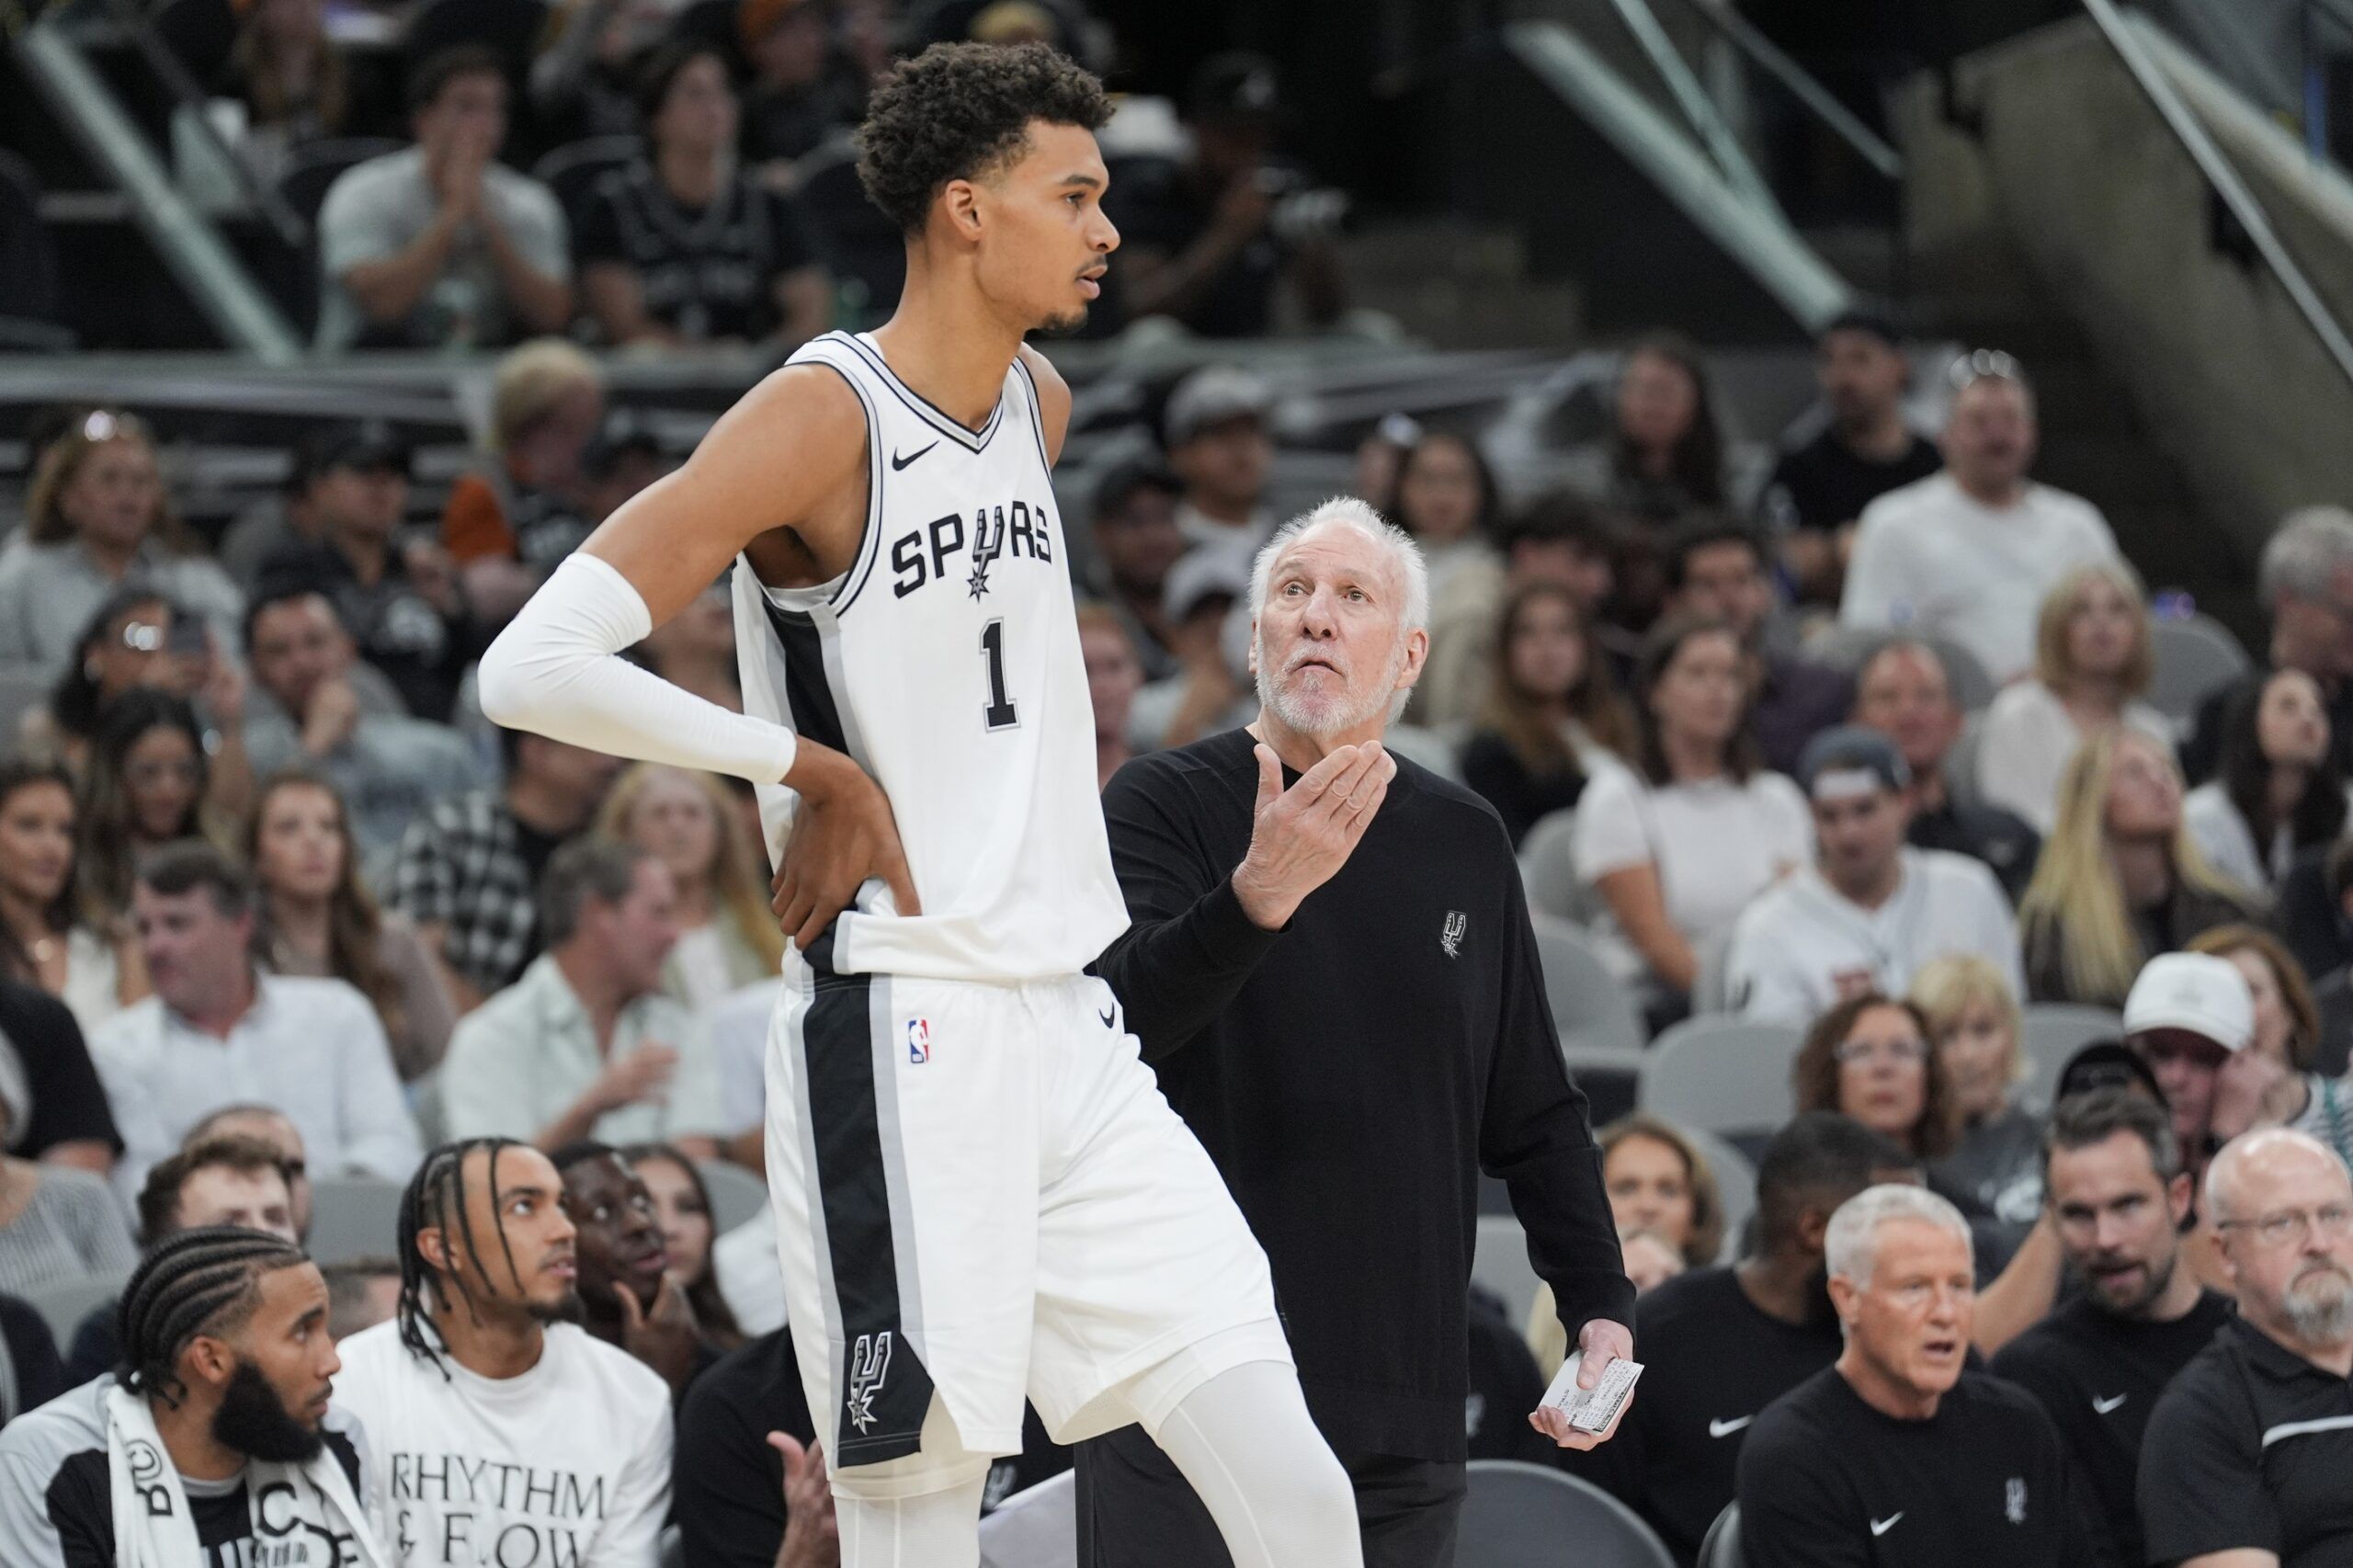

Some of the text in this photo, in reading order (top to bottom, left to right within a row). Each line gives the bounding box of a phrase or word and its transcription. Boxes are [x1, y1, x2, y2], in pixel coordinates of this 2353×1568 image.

[891, 500, 1052, 604] SPURS
[980, 617, 1021, 733] 1
[390, 1452, 604, 1520] RHYTHM
[443, 1512, 600, 1568] FOW
